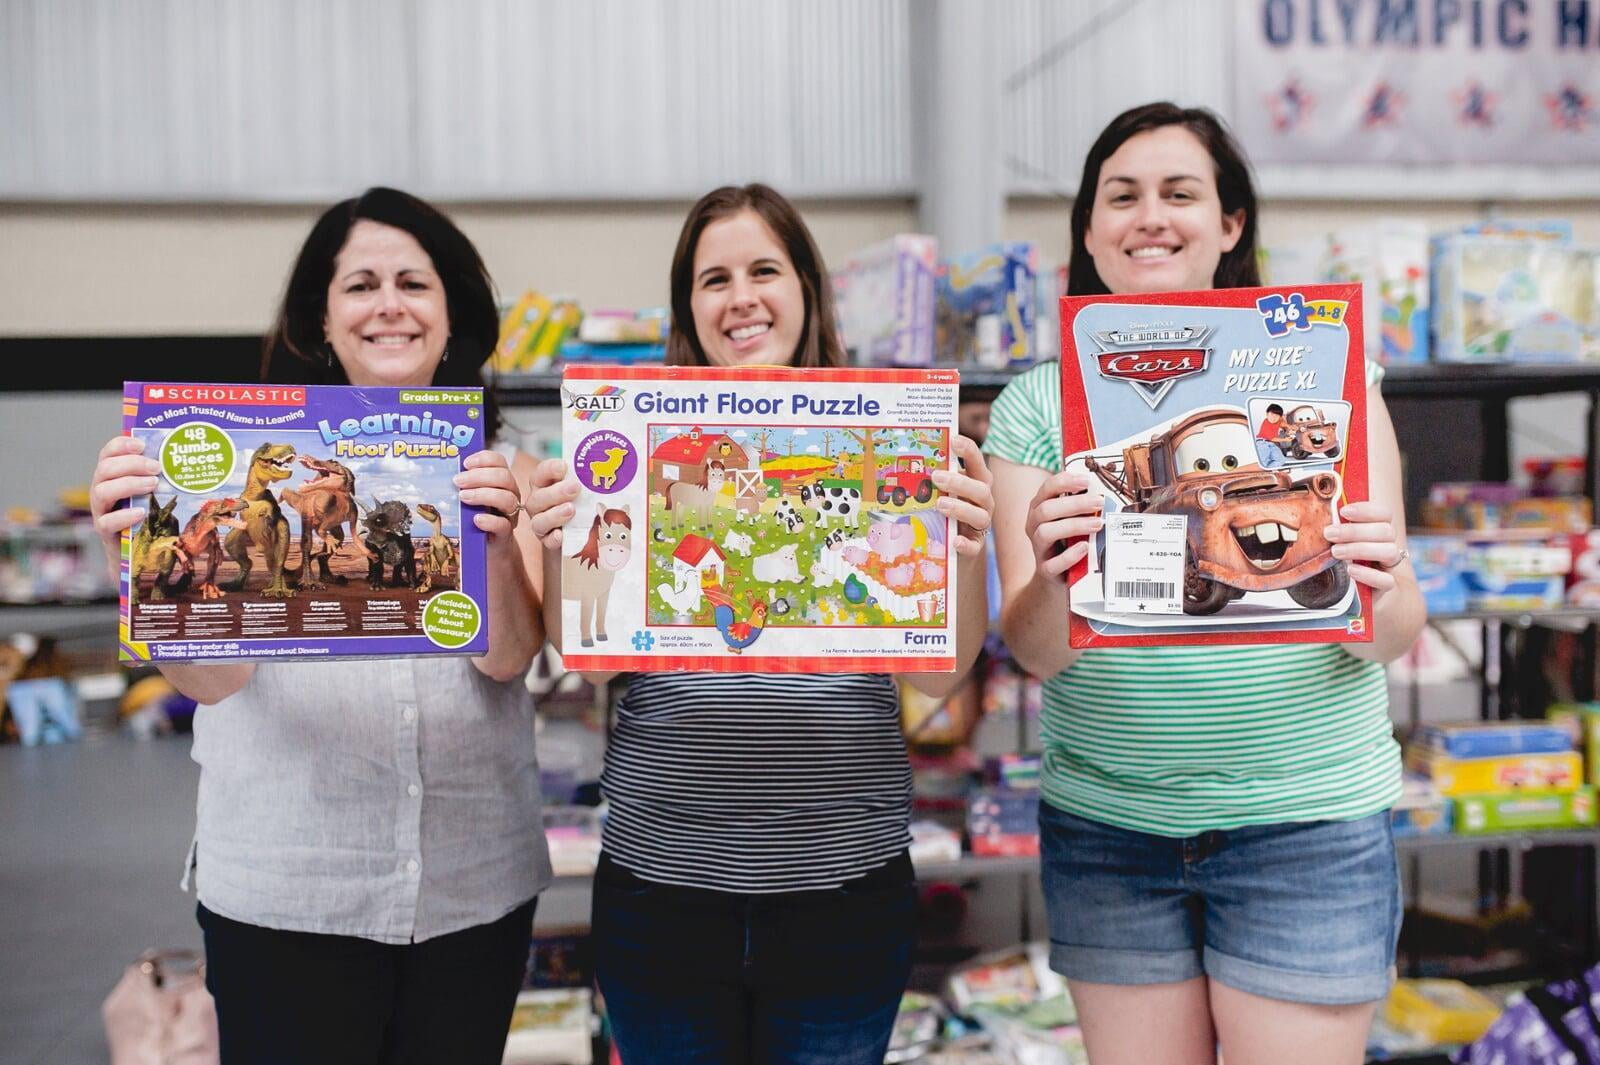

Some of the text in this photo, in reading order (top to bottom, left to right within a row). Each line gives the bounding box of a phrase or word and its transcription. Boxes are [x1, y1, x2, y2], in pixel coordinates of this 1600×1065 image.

[1263, 0, 1600, 48] OLYMPIC H
[1274, 304, 1340, 324] 46 4-8
[1117, 331, 1185, 342] THE WORLD OF
[1107, 354, 1195, 373] Cars
[1228, 348, 1260, 368] MY
[1223, 370, 1318, 394] PUZZLE XL
[168, 388, 303, 401] SCHOLASTIC
[402, 393, 439, 402] Grades
[442, 393, 470, 402] Pre-K
[576, 396, 620, 409] GALT
[633, 391, 880, 416] Giant Floor Puzzle
[144, 406, 305, 427] The Most Trusted Name in Learning
[184, 427, 207, 440] 48
[317, 411, 476, 447] Learning
[169, 440, 220, 456] Jumbo
[336, 439, 460, 458] Floor Puzzle
[578, 434, 603, 461] Template
[604, 433, 628, 448] Pieces
[172, 453, 224, 467] Pieces
[437, 598, 472, 610] Includes
[432, 606, 473, 620] Fun Facts
[438, 617, 464, 628] About
[427, 624, 472, 639] Dinosaurs!
[905, 632, 947, 644] Farm
[157, 644, 187, 652] Develops
[158, 650, 186, 658] Provides
[198, 649, 239, 657] introduction
[250, 648, 276, 656] learning
